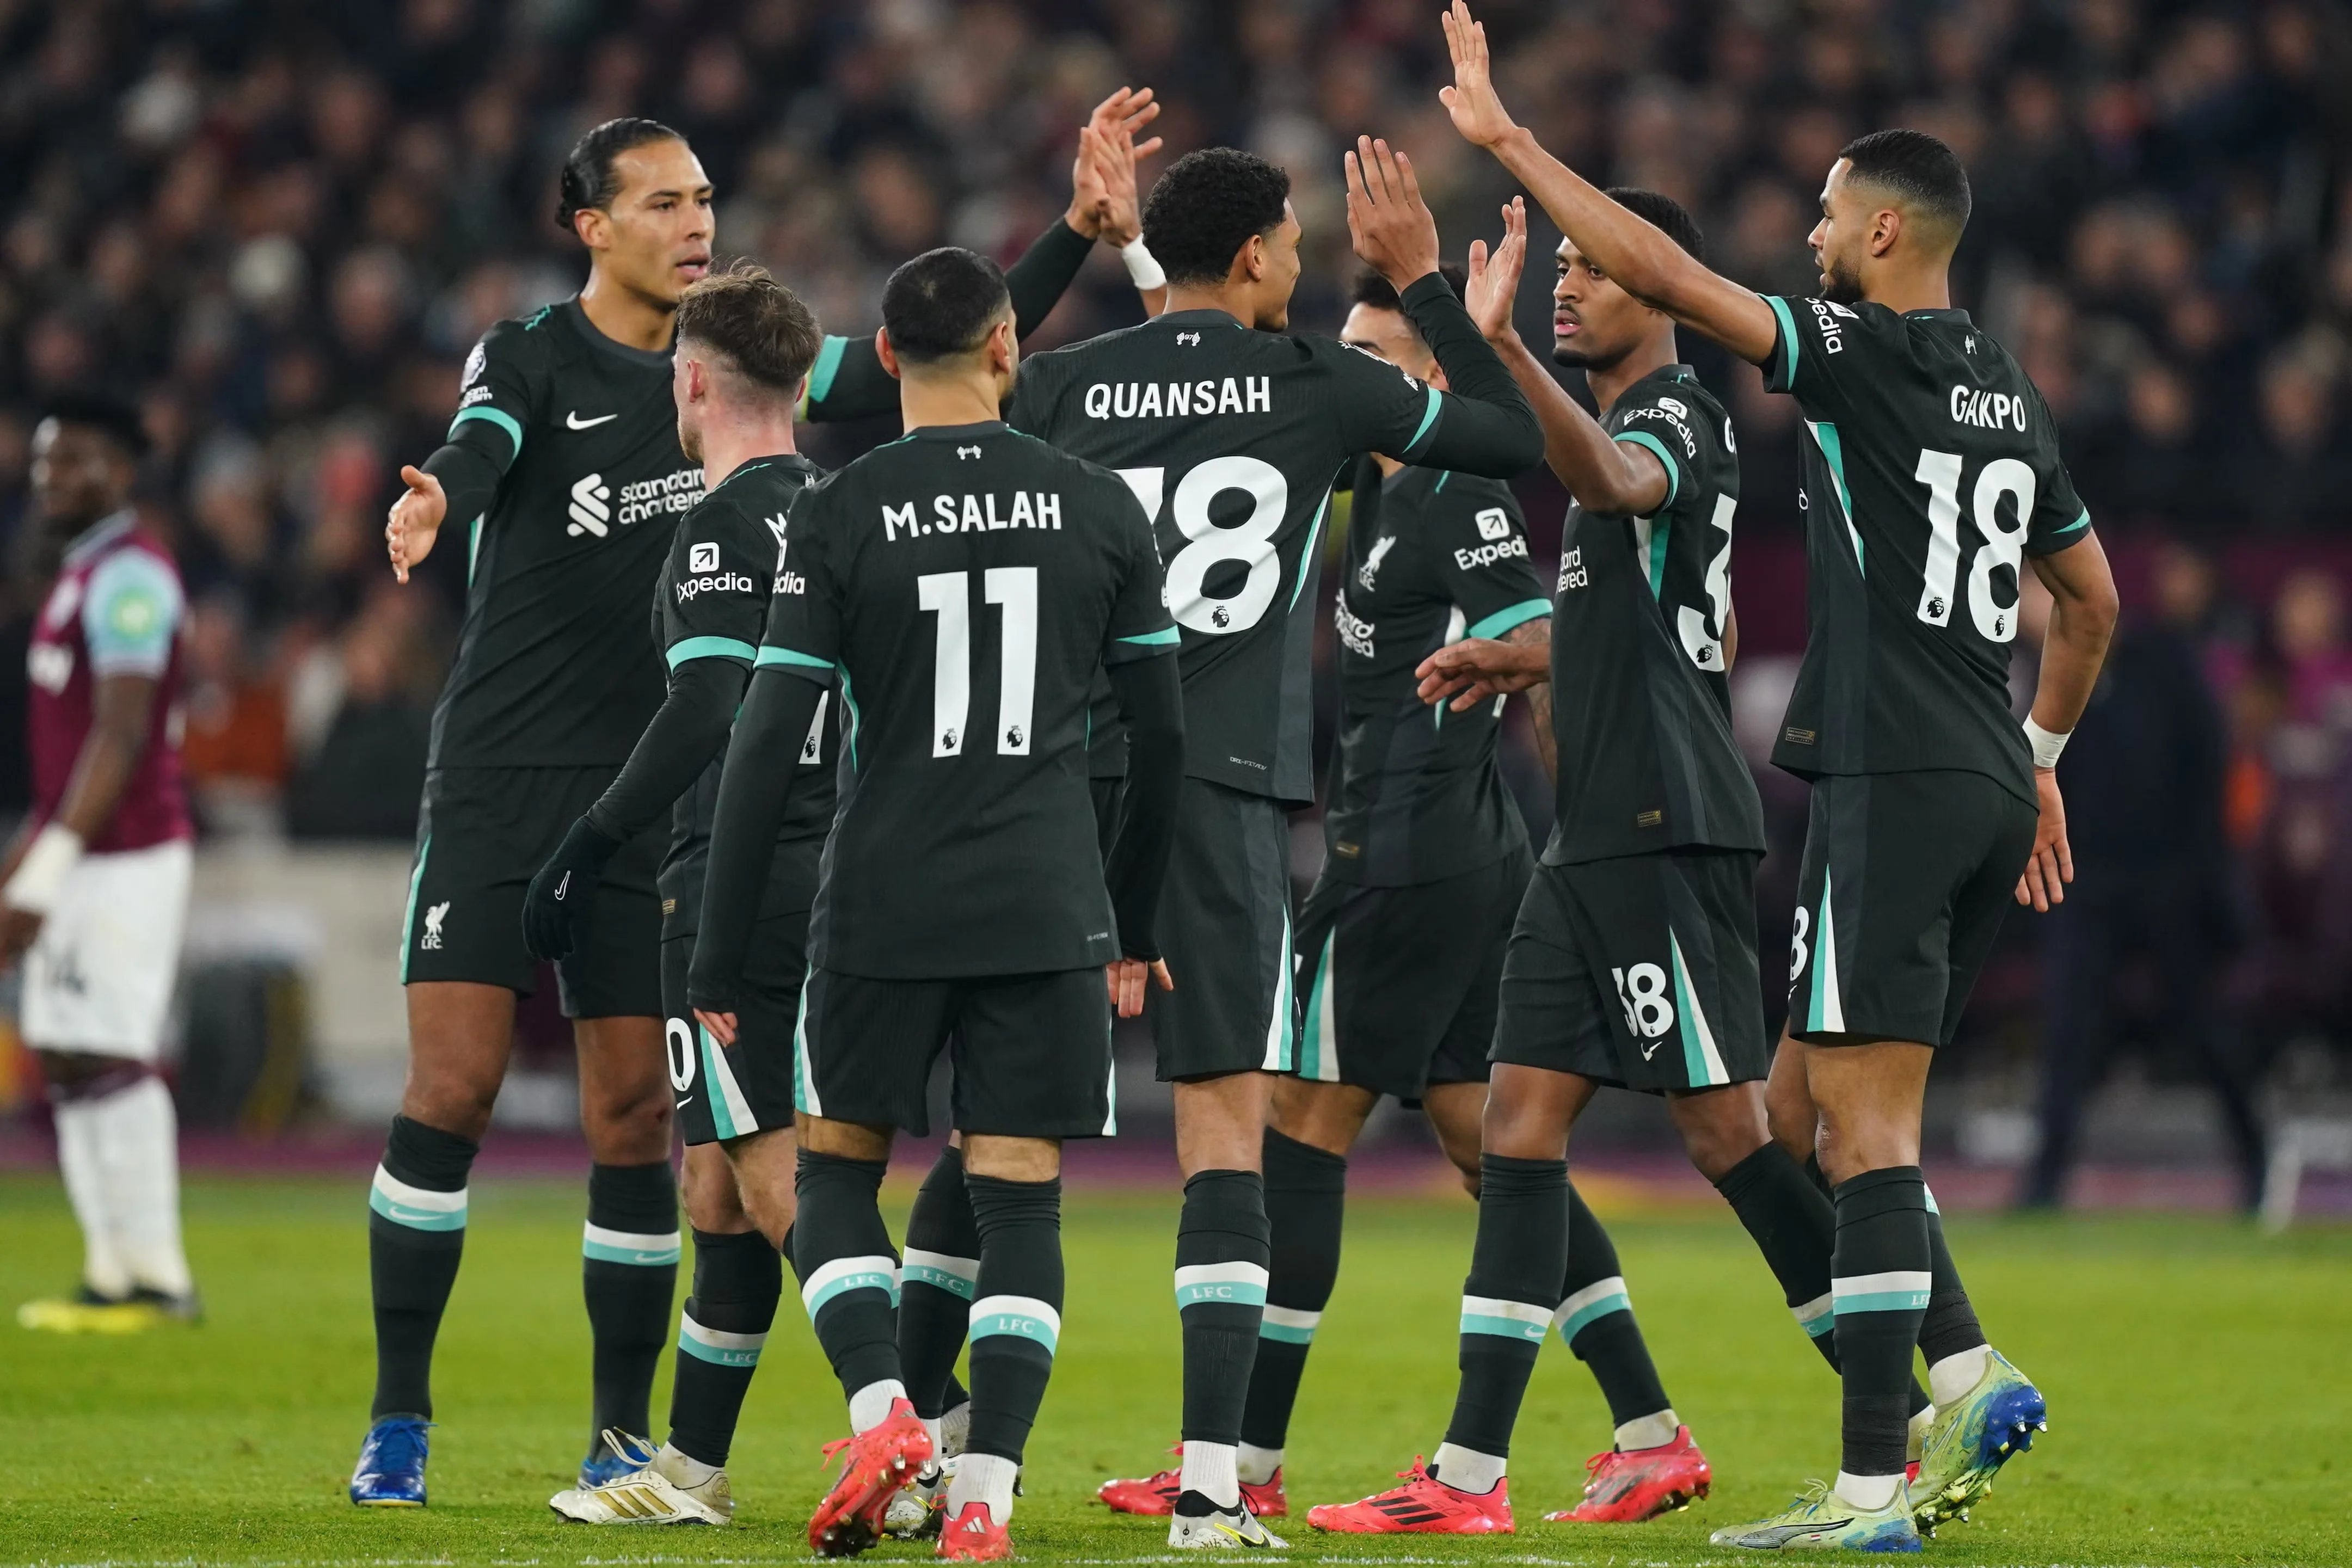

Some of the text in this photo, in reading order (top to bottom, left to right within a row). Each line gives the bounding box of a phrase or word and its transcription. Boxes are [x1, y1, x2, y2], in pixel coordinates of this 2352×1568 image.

[1804, 297, 1843, 354] edia
[1084, 376, 1271, 420] QUANSAH
[1950, 384, 2026, 432] GAKPO
[1624, 408, 1697, 459] Expedia
[618, 489, 708, 525] chartere
[881, 491, 1062, 542] M.SALAH
[1454, 534, 1530, 570] Expedi
[1914, 448, 2036, 643] 18
[1677, 492, 1737, 672] 3
[917, 566, 1037, 758] 11
[421, 938, 444, 950] LFC
[1790, 906, 1810, 981] 8
[665, 1017, 696, 1092] 0
[845, 1275, 880, 1287] LFC
[922, 1269, 965, 1292] LFC
[1191, 1286, 1232, 1299] LFC
[998, 1317, 1036, 1333] LFC
[722, 1351, 758, 1363] LFC
